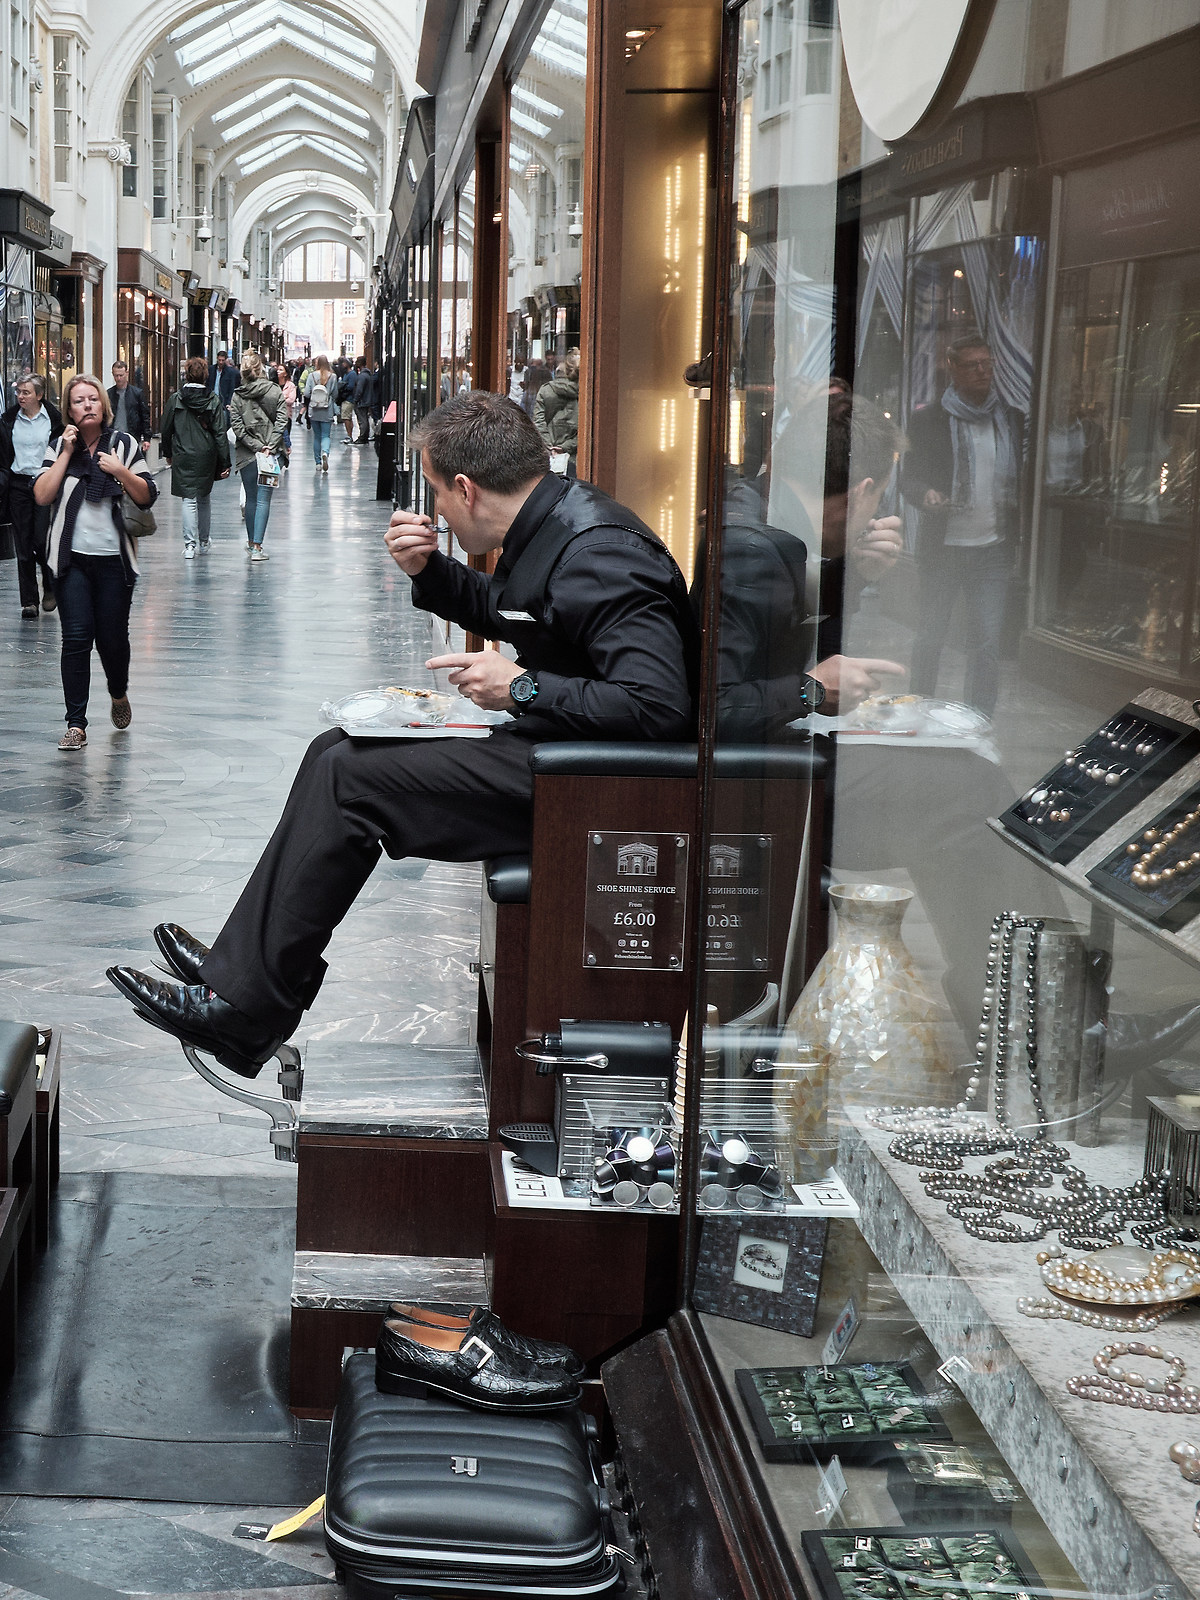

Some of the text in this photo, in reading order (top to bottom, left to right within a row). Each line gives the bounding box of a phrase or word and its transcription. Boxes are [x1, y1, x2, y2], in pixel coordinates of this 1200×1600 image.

[596, 884, 676, 894] SHOE SHINE SERVICE
[613, 912, 656, 926] £6.00
